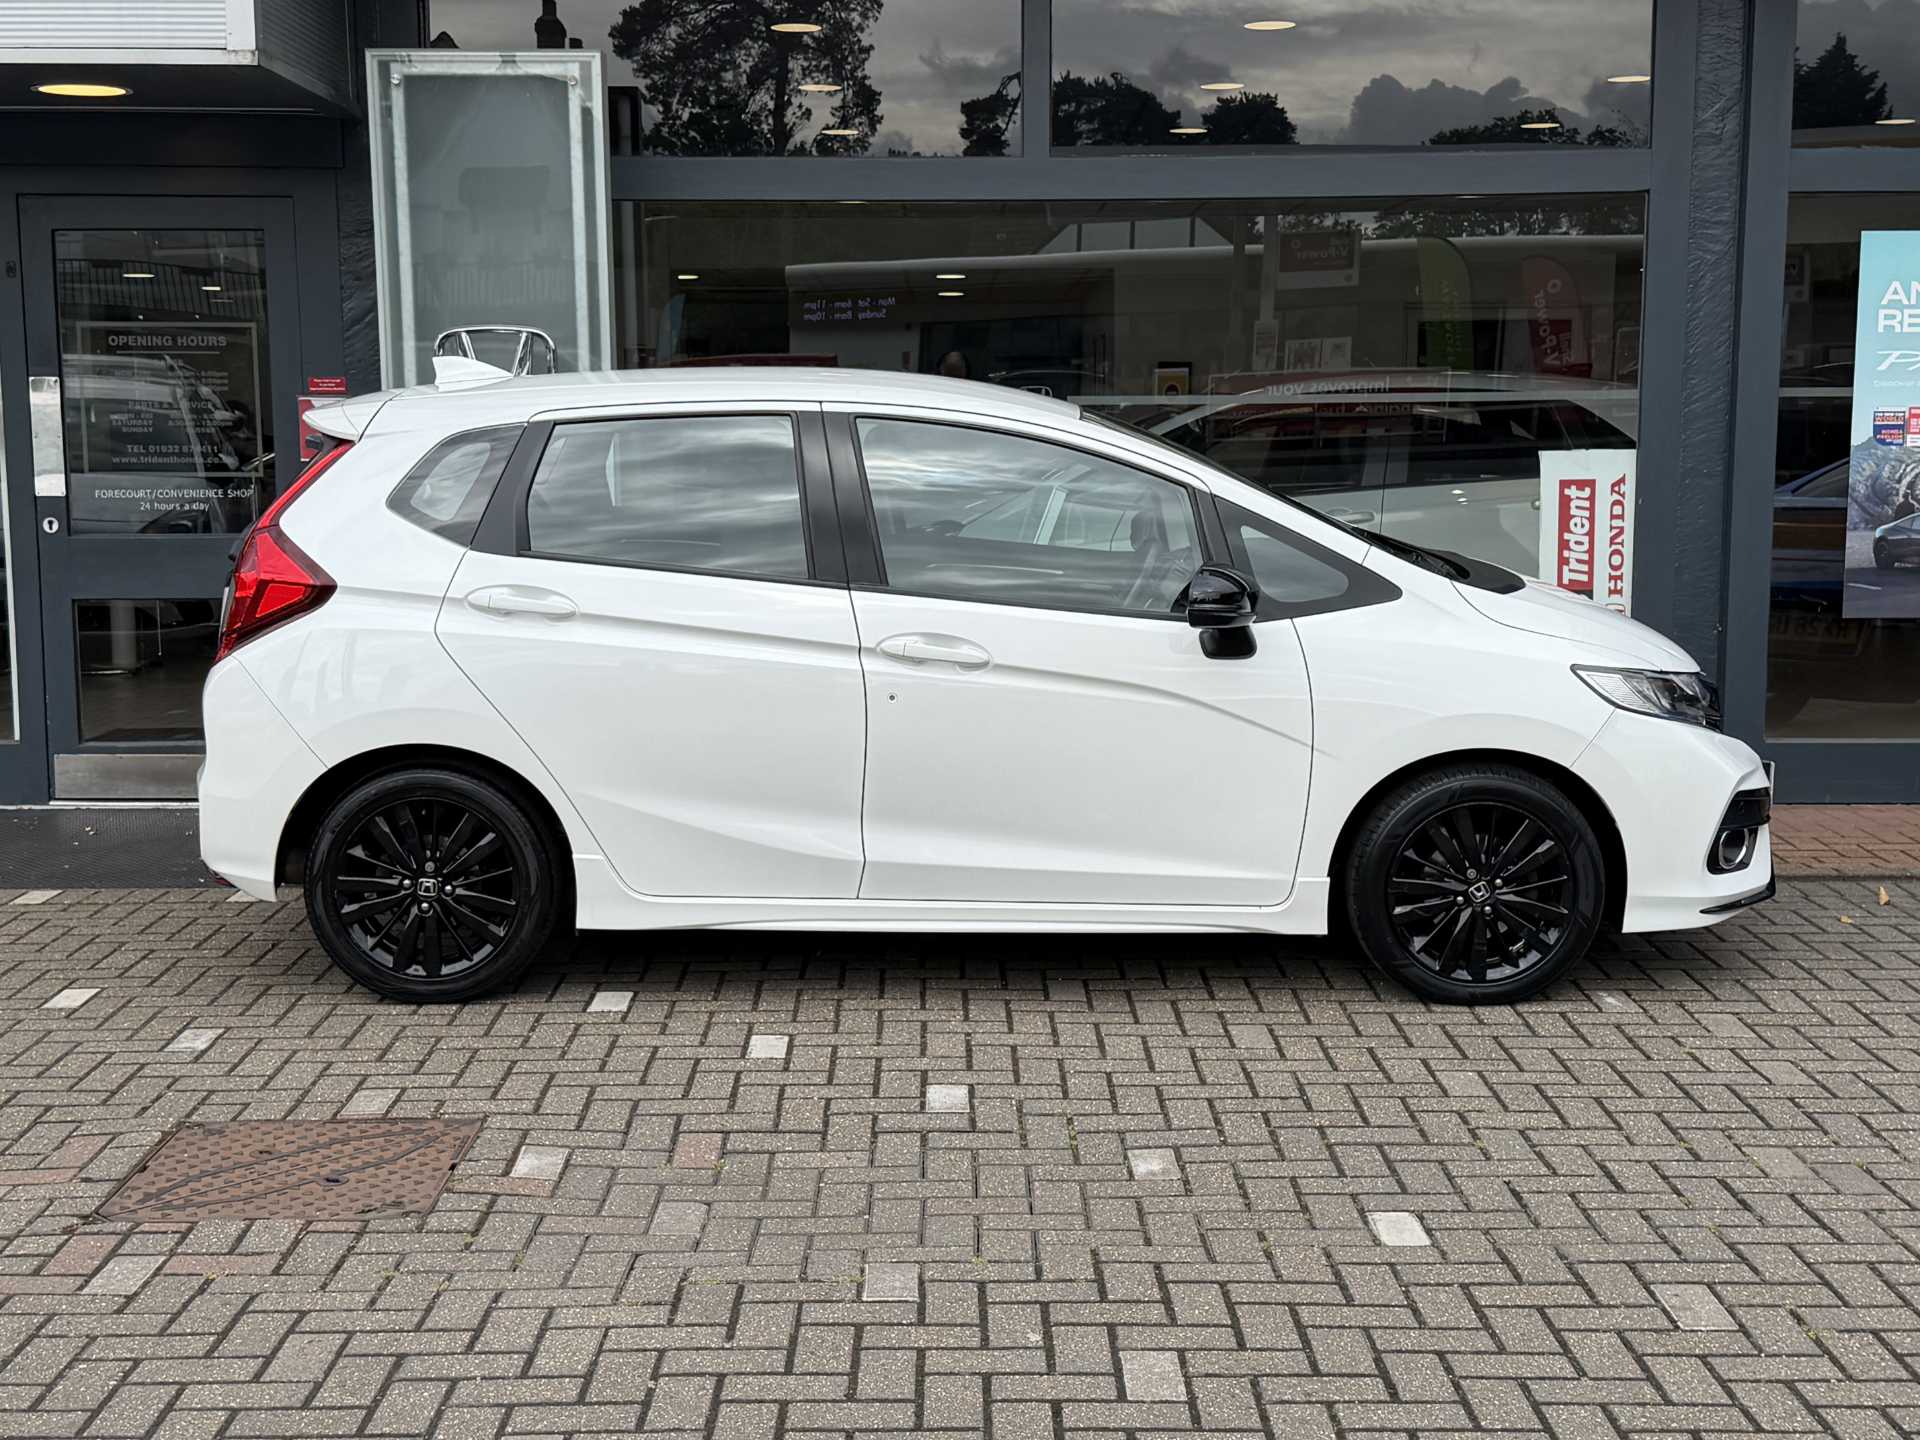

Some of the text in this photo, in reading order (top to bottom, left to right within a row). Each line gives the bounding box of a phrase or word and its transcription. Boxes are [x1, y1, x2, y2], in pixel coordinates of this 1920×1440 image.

[108, 334, 227, 347] OPENING HOURS
[127, 444, 146, 453] TEL
[95, 488, 254, 499] FORECOURT/CONVENIENCE SHOP
[140, 501, 151, 511] 24
[154, 501, 181, 511] hours
[192, 501, 210, 513] day
[1562, 484, 1592, 585] Trident
[1608, 474, 1627, 598] HONDA
